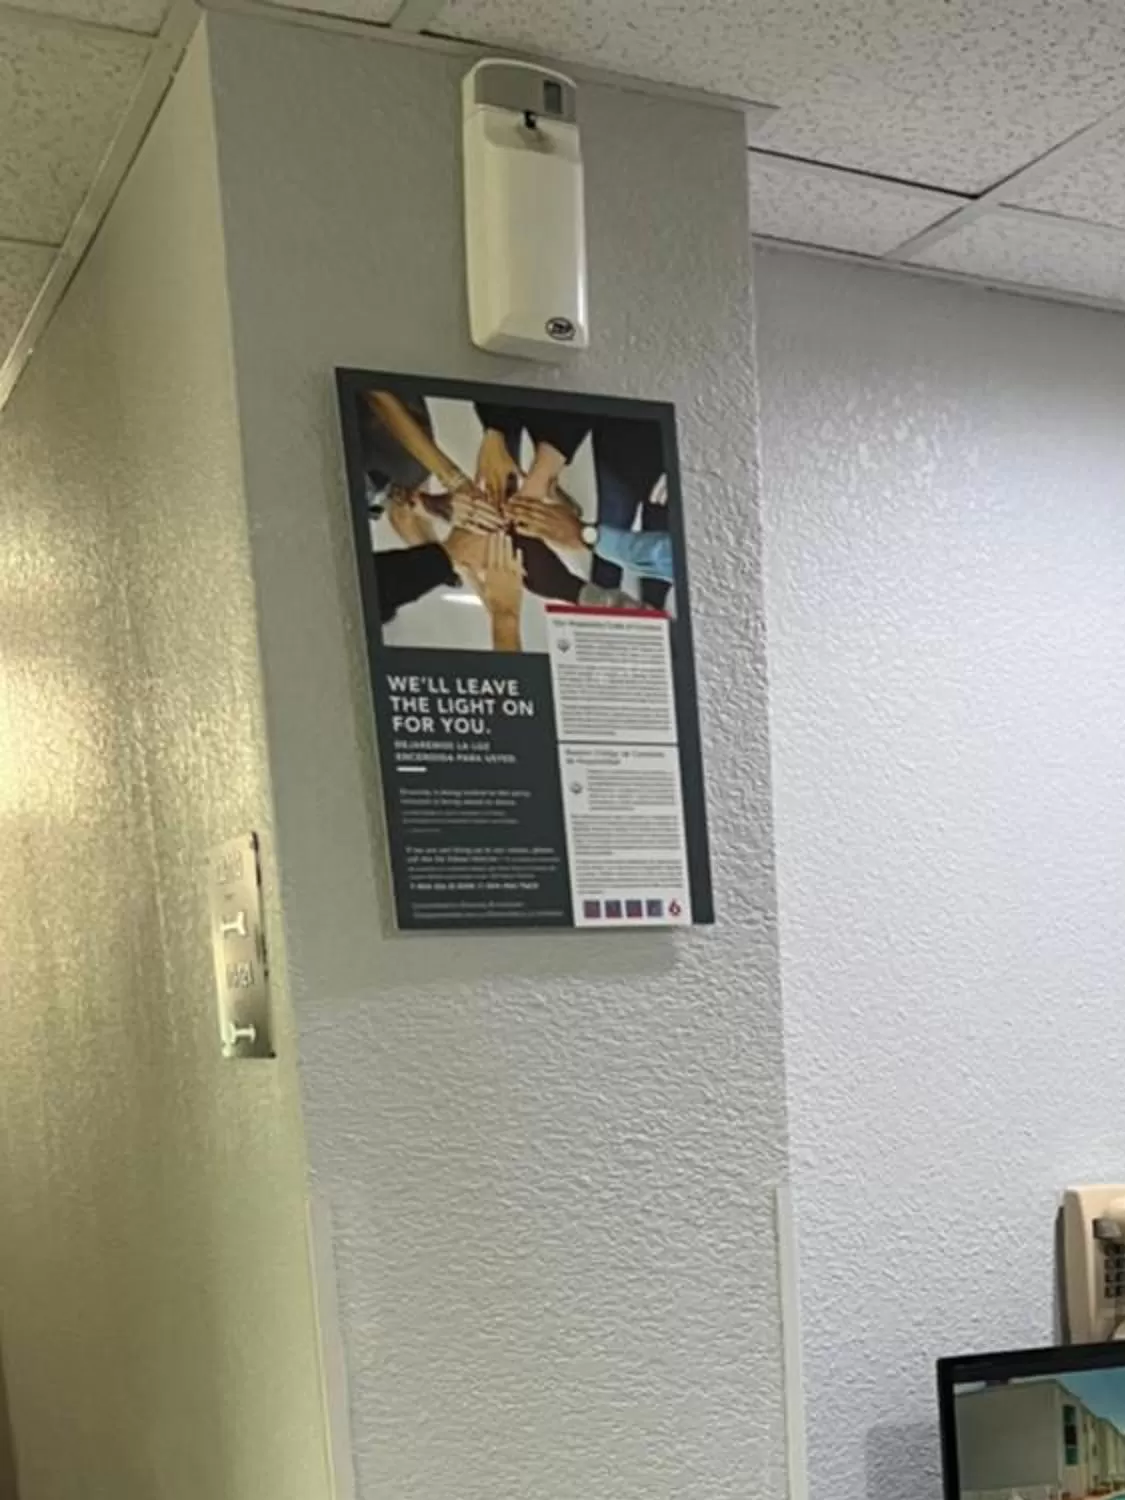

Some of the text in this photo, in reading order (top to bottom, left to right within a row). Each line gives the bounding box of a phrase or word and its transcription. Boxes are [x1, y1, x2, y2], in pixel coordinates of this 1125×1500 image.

[386, 674, 520, 697] WE'LL LEAVE
[389, 695, 535, 717] THE LIGHT ON
[392, 715, 492, 735] FOR YOU.
